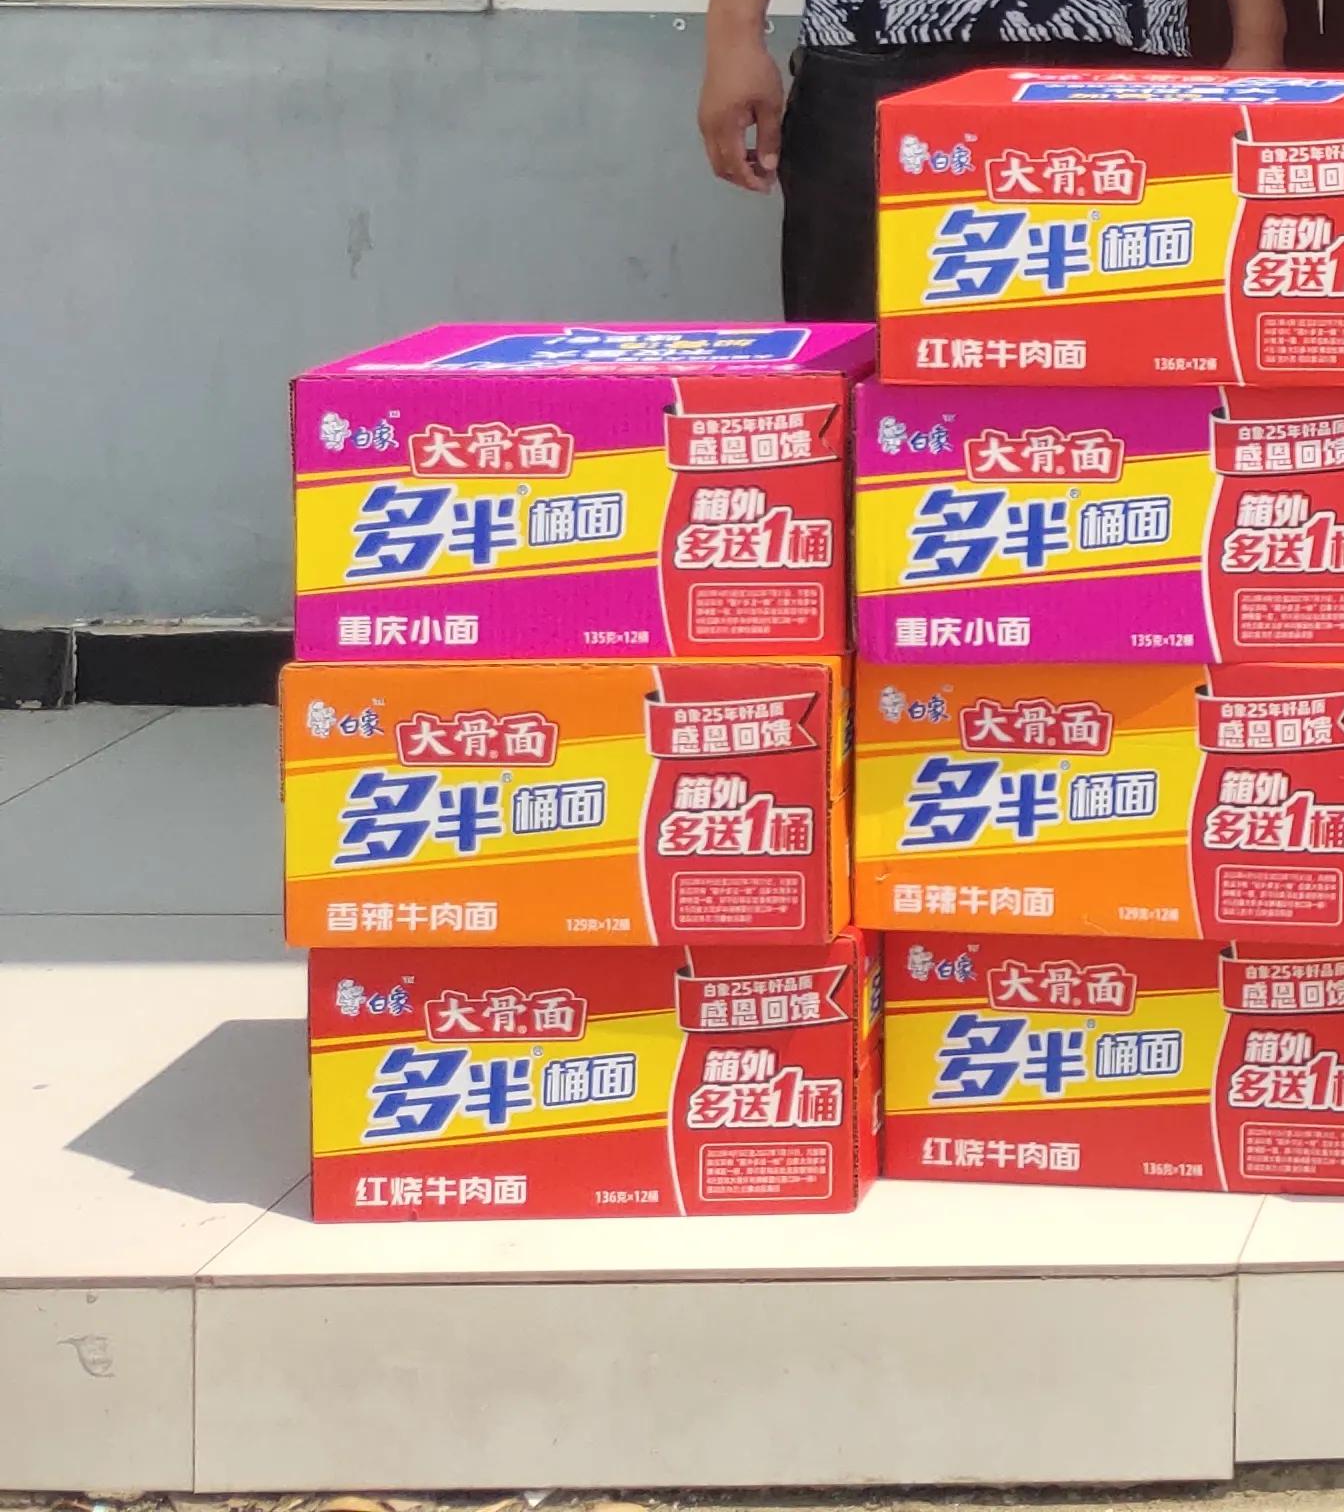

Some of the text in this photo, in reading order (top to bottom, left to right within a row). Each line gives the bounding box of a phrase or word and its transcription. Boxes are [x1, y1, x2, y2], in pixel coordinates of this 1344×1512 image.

[998, 156, 1133, 196] 大骨面
[1261, 217, 1330, 251] 箱外
[925, 210, 1193, 301] 多半 桶面
[917, 339, 1087, 370] 红烧牛肉面
[421, 436, 561, 470] 大骨面
[689, 432, 811, 465] 感恩回馈
[974, 432, 1112, 476] 大骨面
[693, 489, 764, 520] 箱外
[1238, 492, 1309, 525] 箱外
[346, 485, 622, 578] 多半 桶面
[676, 510, 832, 568] 多送1桶
[903, 490, 1170, 580] 多半 桶面
[339, 615, 479, 646] 重庆小面
[895, 617, 1030, 647] 重庆小面
[409, 720, 547, 760] 大骨面
[671, 722, 792, 753] 感恩回馈
[972, 706, 1100, 746] 大骨面
[1217, 717, 1333, 748] 感恩回馈
[676, 776, 746, 808] 箱外
[901, 757, 1157, 846] 多半 桶面
[1220, 770, 1288, 804] 箱外
[333, 772, 606, 865] 多半 桶面
[660, 795, 814, 855] 多送1桶
[326, 901, 497, 932] 香辣牛肉面
[893, 884, 1055, 918] 香辣牛肉面
[999, 968, 1124, 1008] 大骨面
[437, 996, 574, 1035] 大骨面
[700, 994, 820, 1027] 感恩回馈
[933, 1015, 1183, 1099] 多半 桶面
[1244, 1031, 1313, 1063] 箱外
[704, 1048, 774, 1083] 箱外
[365, 1047, 637, 1138] 多半 桶面
[687, 1067, 843, 1128] 多送1桶
[921, 1137, 1081, 1169] 红烧牛肉面
[355, 1175, 527, 1207] 红烧牛肉面
